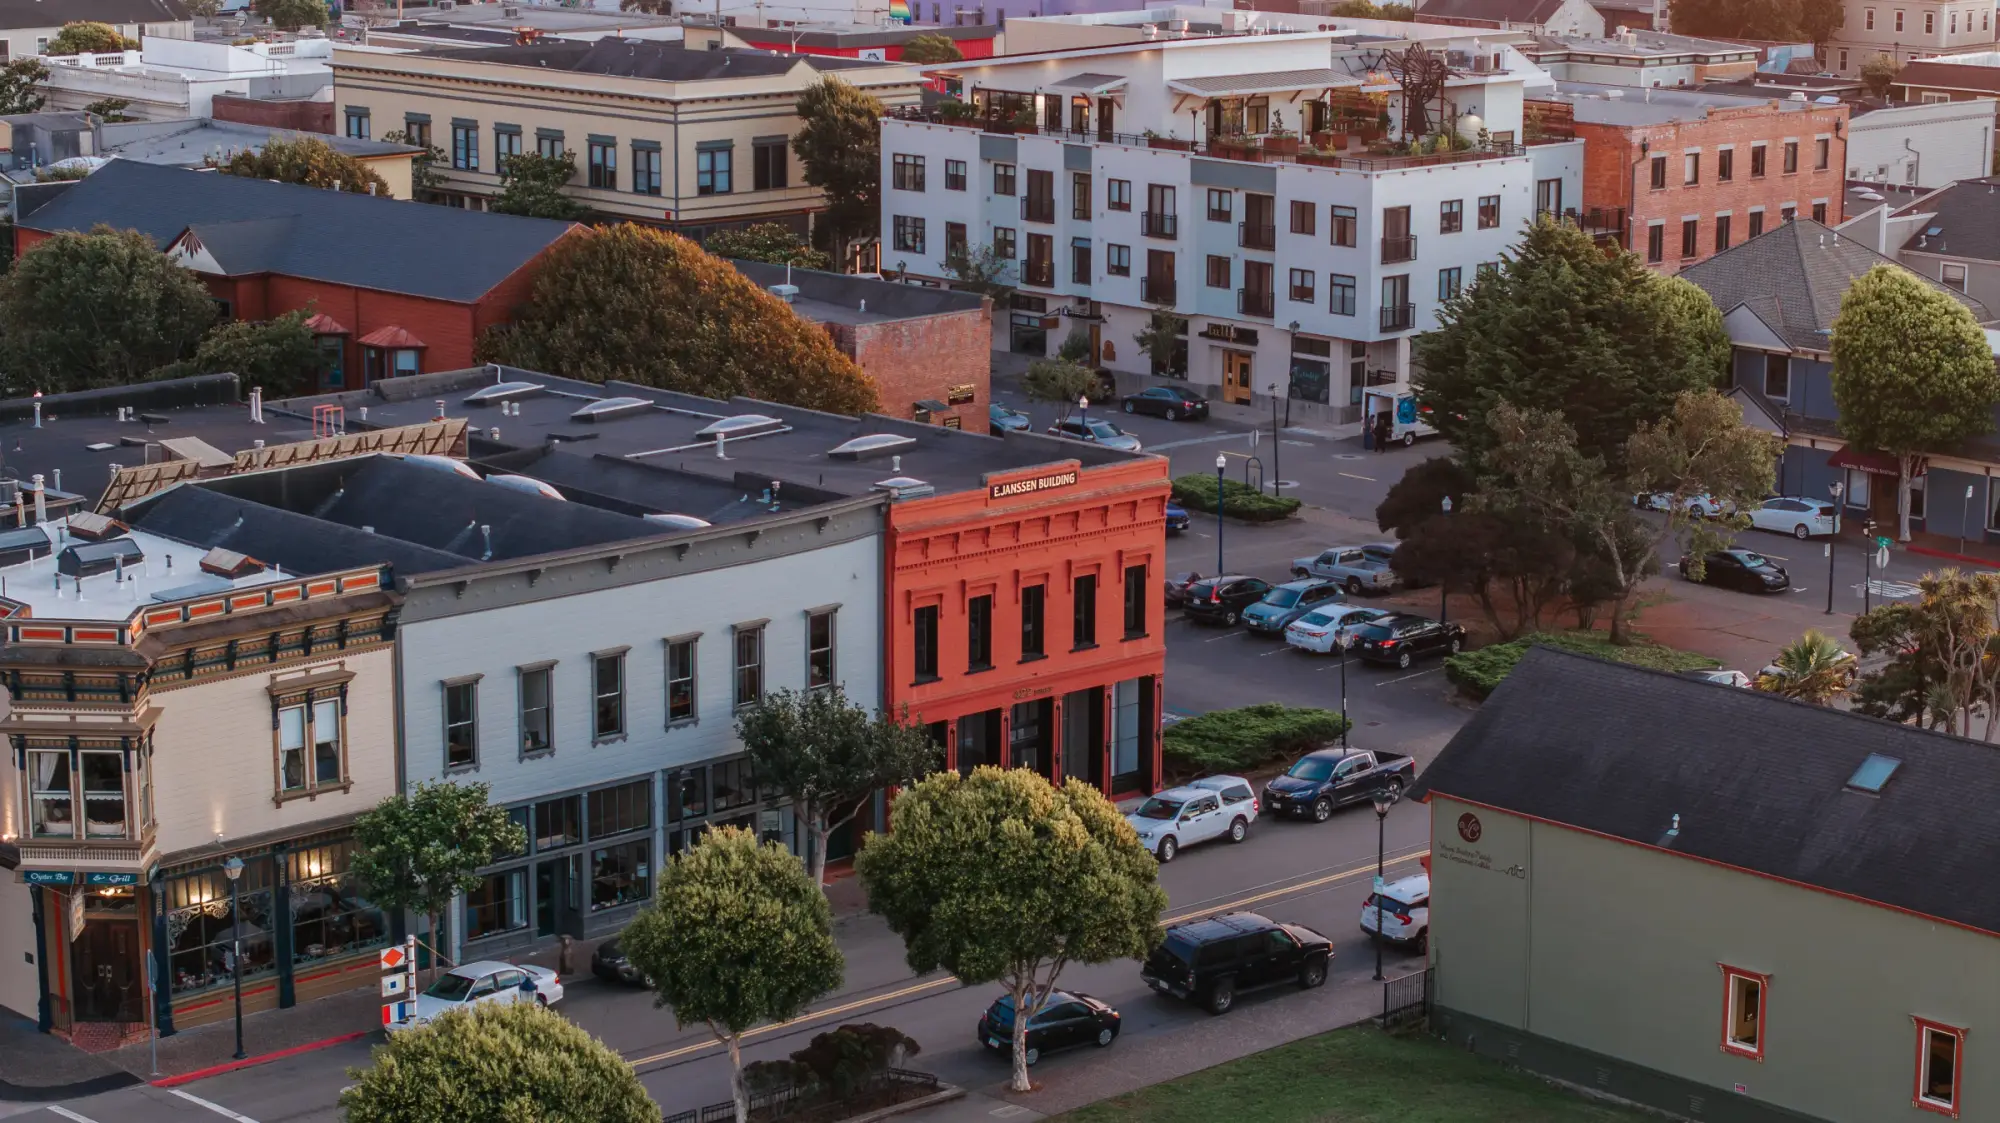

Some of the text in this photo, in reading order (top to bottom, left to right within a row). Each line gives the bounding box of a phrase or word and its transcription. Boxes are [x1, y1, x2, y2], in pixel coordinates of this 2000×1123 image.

[1038, 473, 1075, 489] BUILDING
[30, 872, 53, 881] Oyster
[54, 873, 69, 881] Bar
[108, 874, 131, 883] Grill
